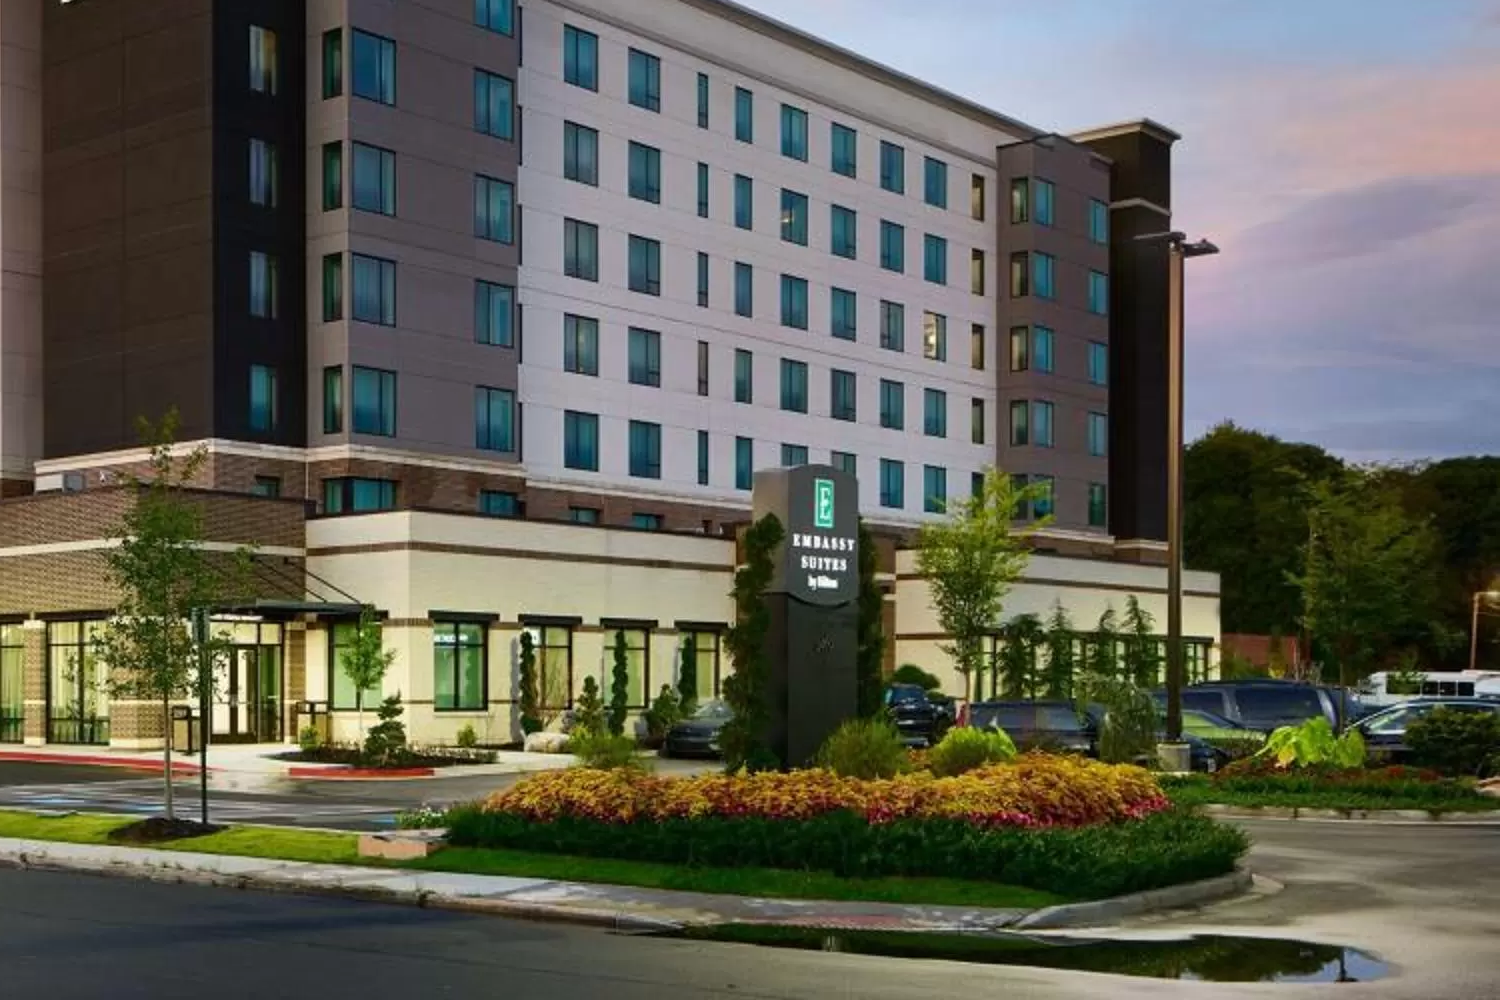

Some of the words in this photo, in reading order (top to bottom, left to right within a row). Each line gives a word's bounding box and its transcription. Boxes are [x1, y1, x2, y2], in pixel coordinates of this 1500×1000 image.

[819, 487, 831, 520] E
[792, 533, 856, 551] EMBASSY
[801, 555, 847, 572] SUITES
